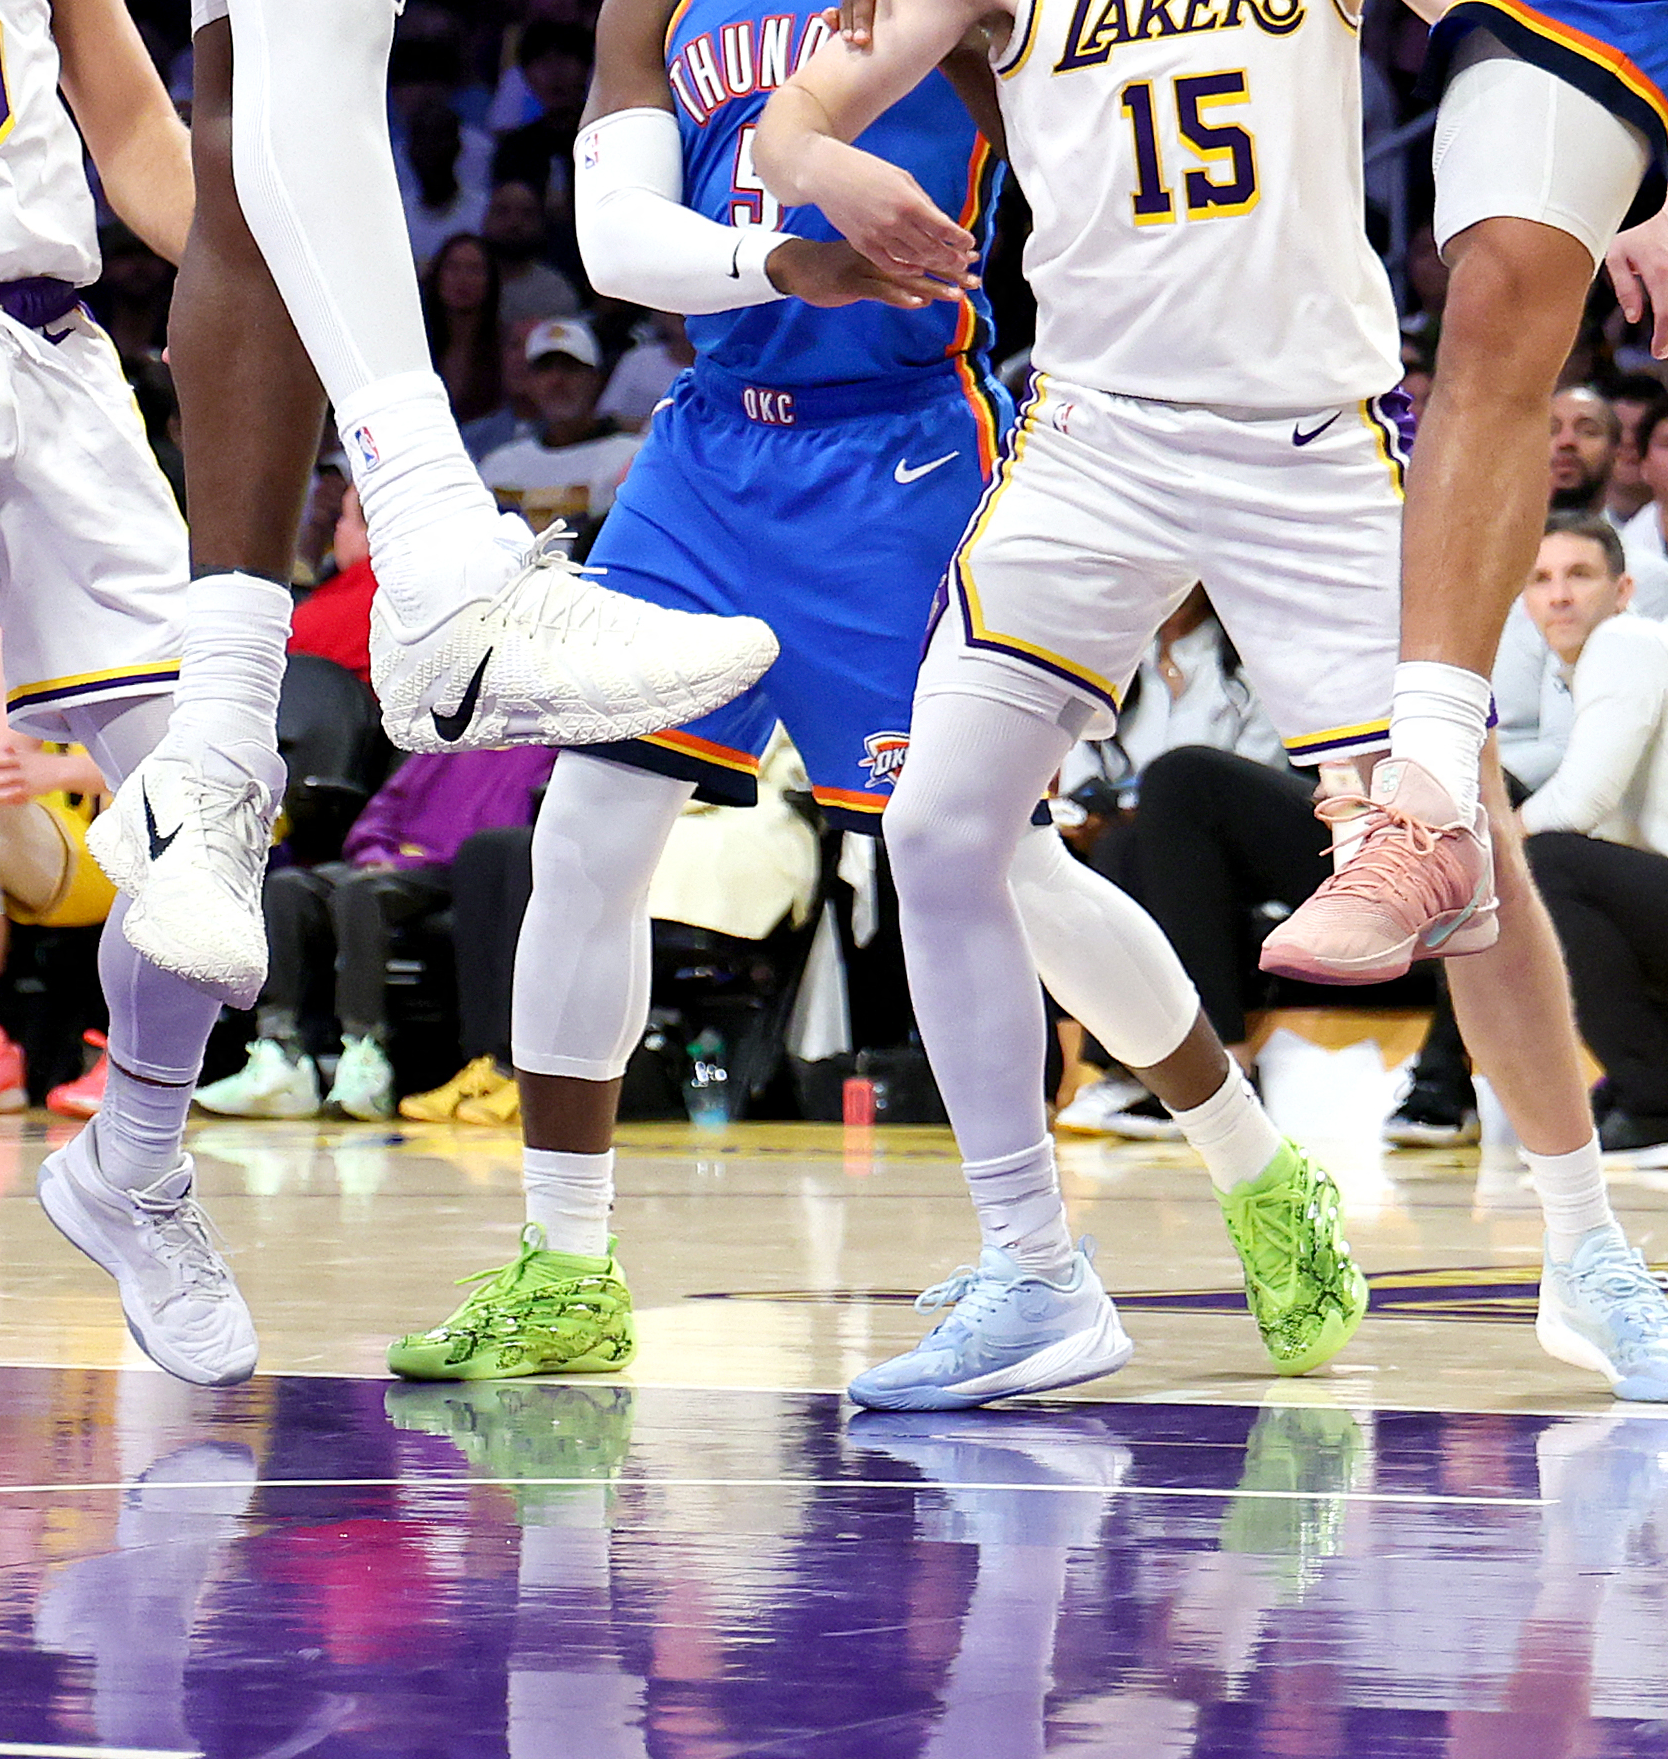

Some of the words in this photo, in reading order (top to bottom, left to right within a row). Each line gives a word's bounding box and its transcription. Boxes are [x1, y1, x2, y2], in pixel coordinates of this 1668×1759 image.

[1120, 67, 1261, 226] 15
[741, 387, 796, 425] OKC
[874, 747, 909, 778] OK
